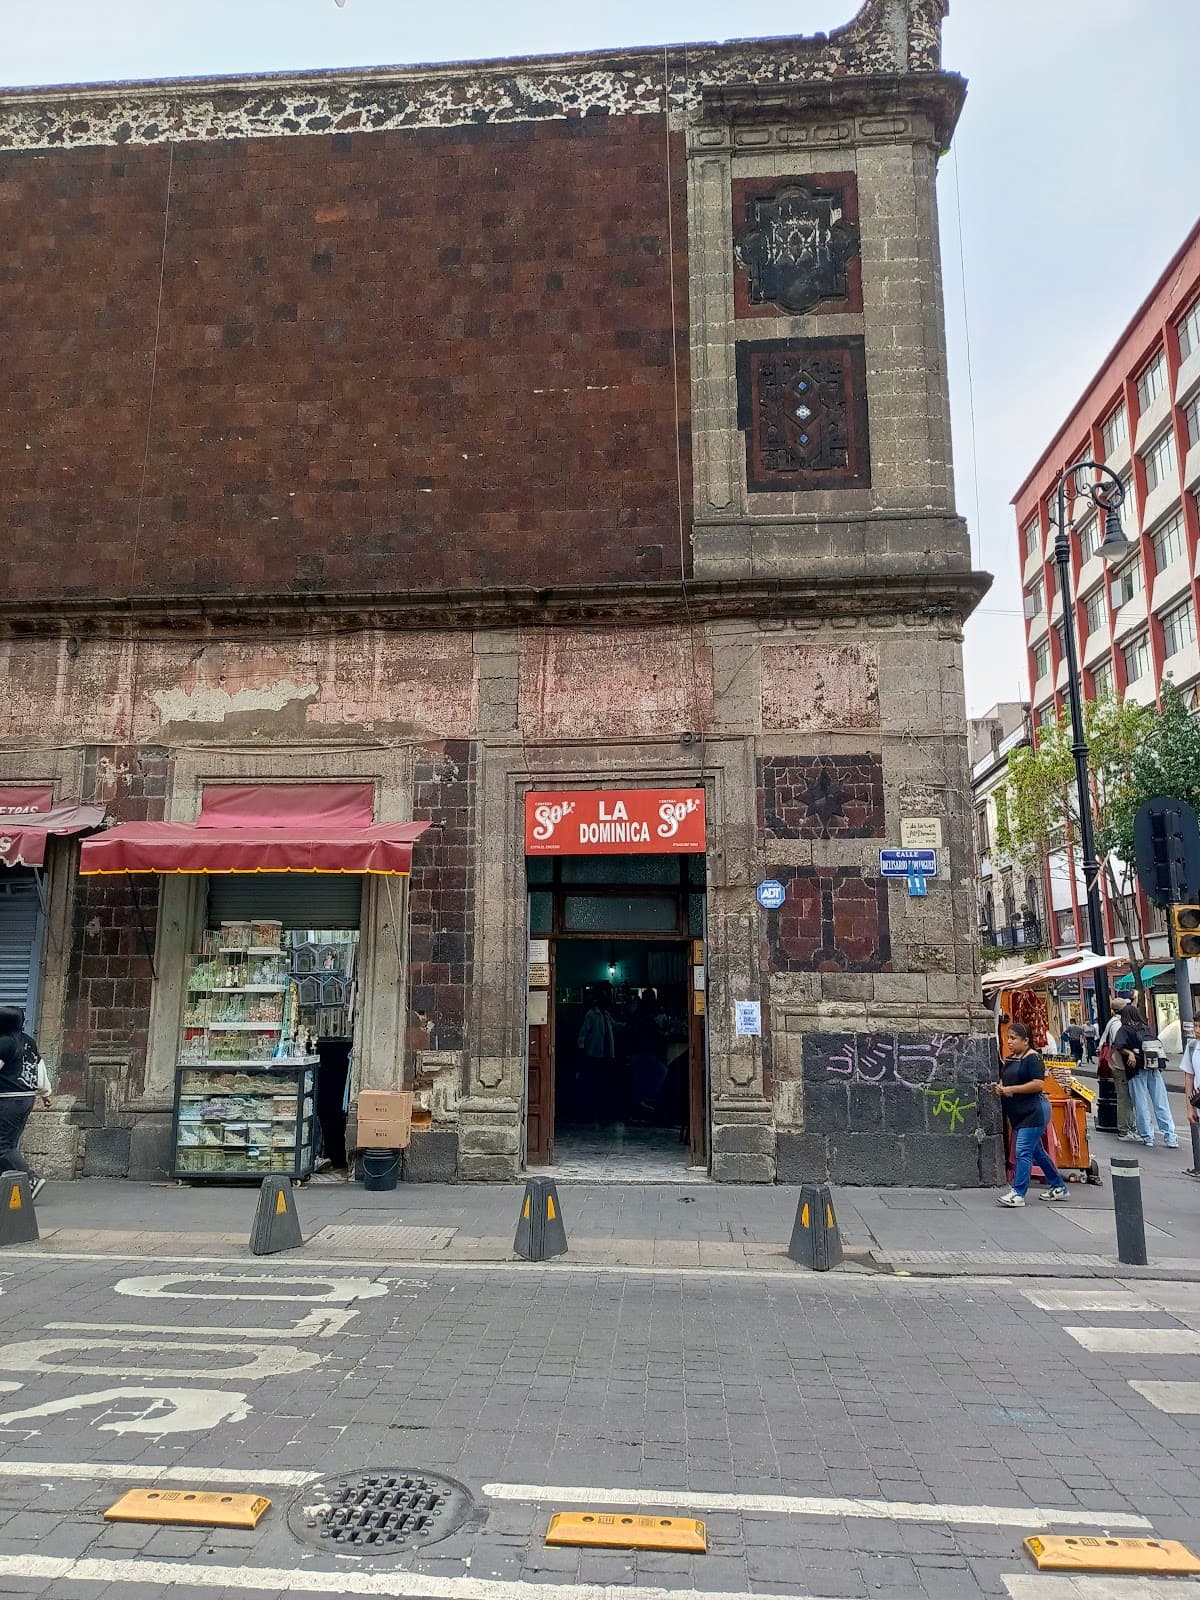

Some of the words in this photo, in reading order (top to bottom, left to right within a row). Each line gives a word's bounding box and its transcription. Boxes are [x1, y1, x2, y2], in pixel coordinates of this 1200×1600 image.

[599, 801, 629, 820] LA
[579, 821, 651, 843] DOMINICA
[908, 860, 934, 870] OMINGUEZ
[761, 887, 781, 899] ADT
